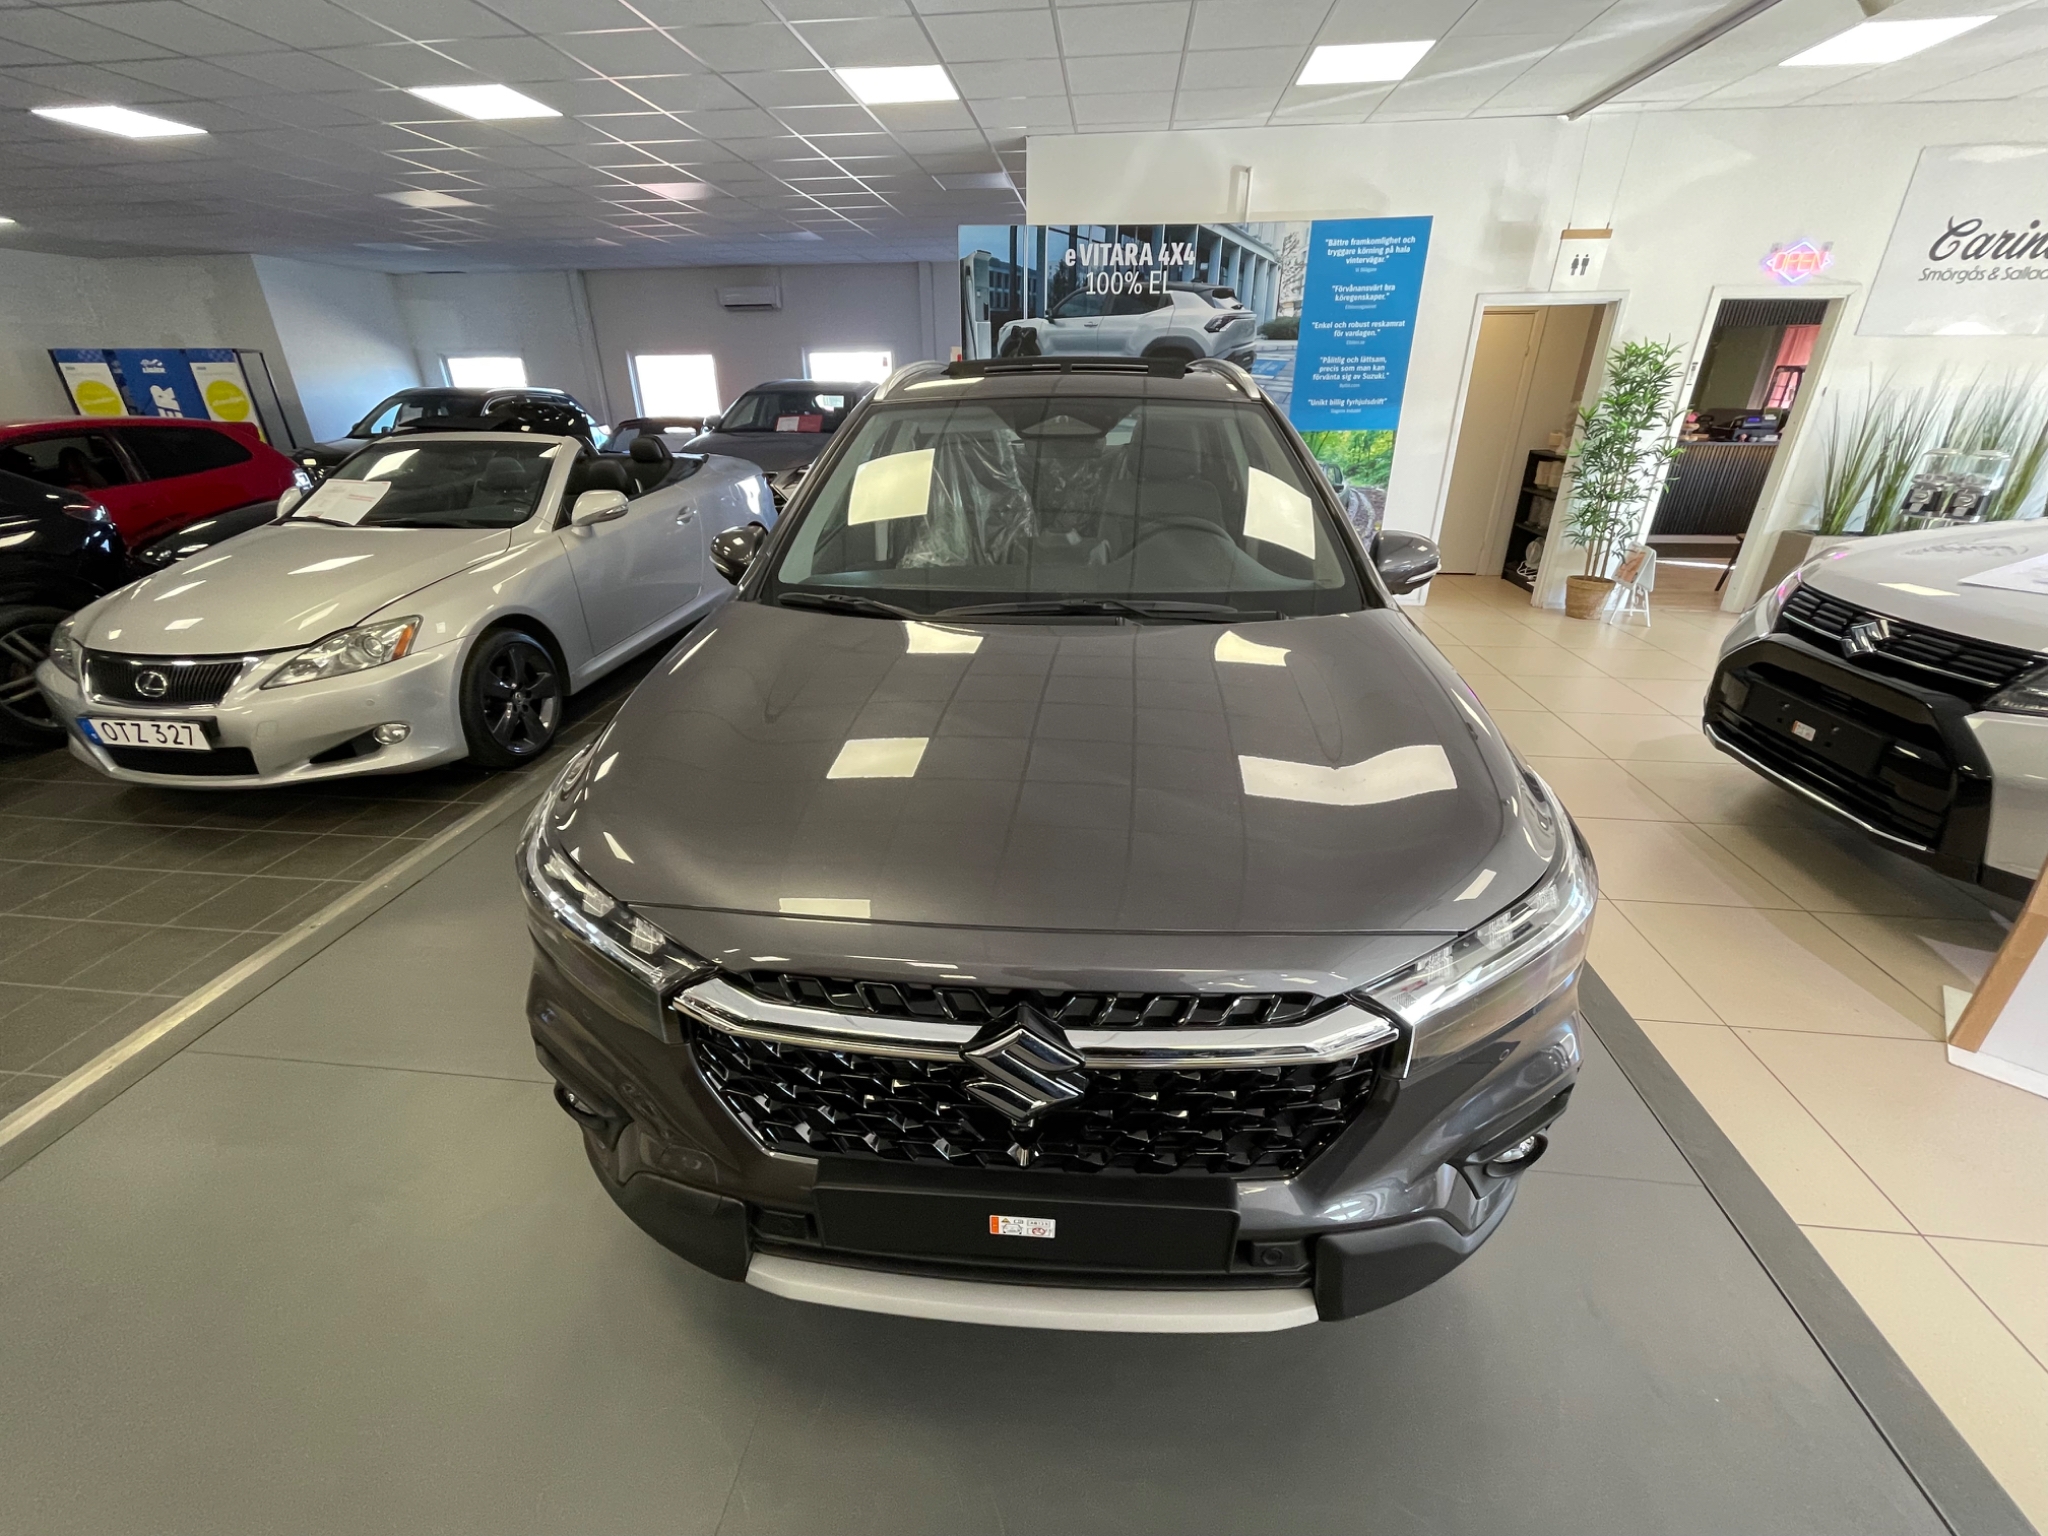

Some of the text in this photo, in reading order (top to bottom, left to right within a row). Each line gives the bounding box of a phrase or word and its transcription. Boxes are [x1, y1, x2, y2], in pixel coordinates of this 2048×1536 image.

[1327, 248, 1356, 257] tryggare
[1358, 247, 1384, 255] körning
[1385, 245, 1394, 254] på
[1402, 236, 1416, 244] och
[1080, 243, 1153, 266] VITARA
[1158, 242, 1196, 265] 4X4
[1772, 250, 1829, 272] OPEN
[1086, 270, 1171, 295] 100% EL
[1918, 265, 1987, 284] Smörgås
[1987, 267, 2000, 281] &
[101, 722, 193, 746] OTZ 327
